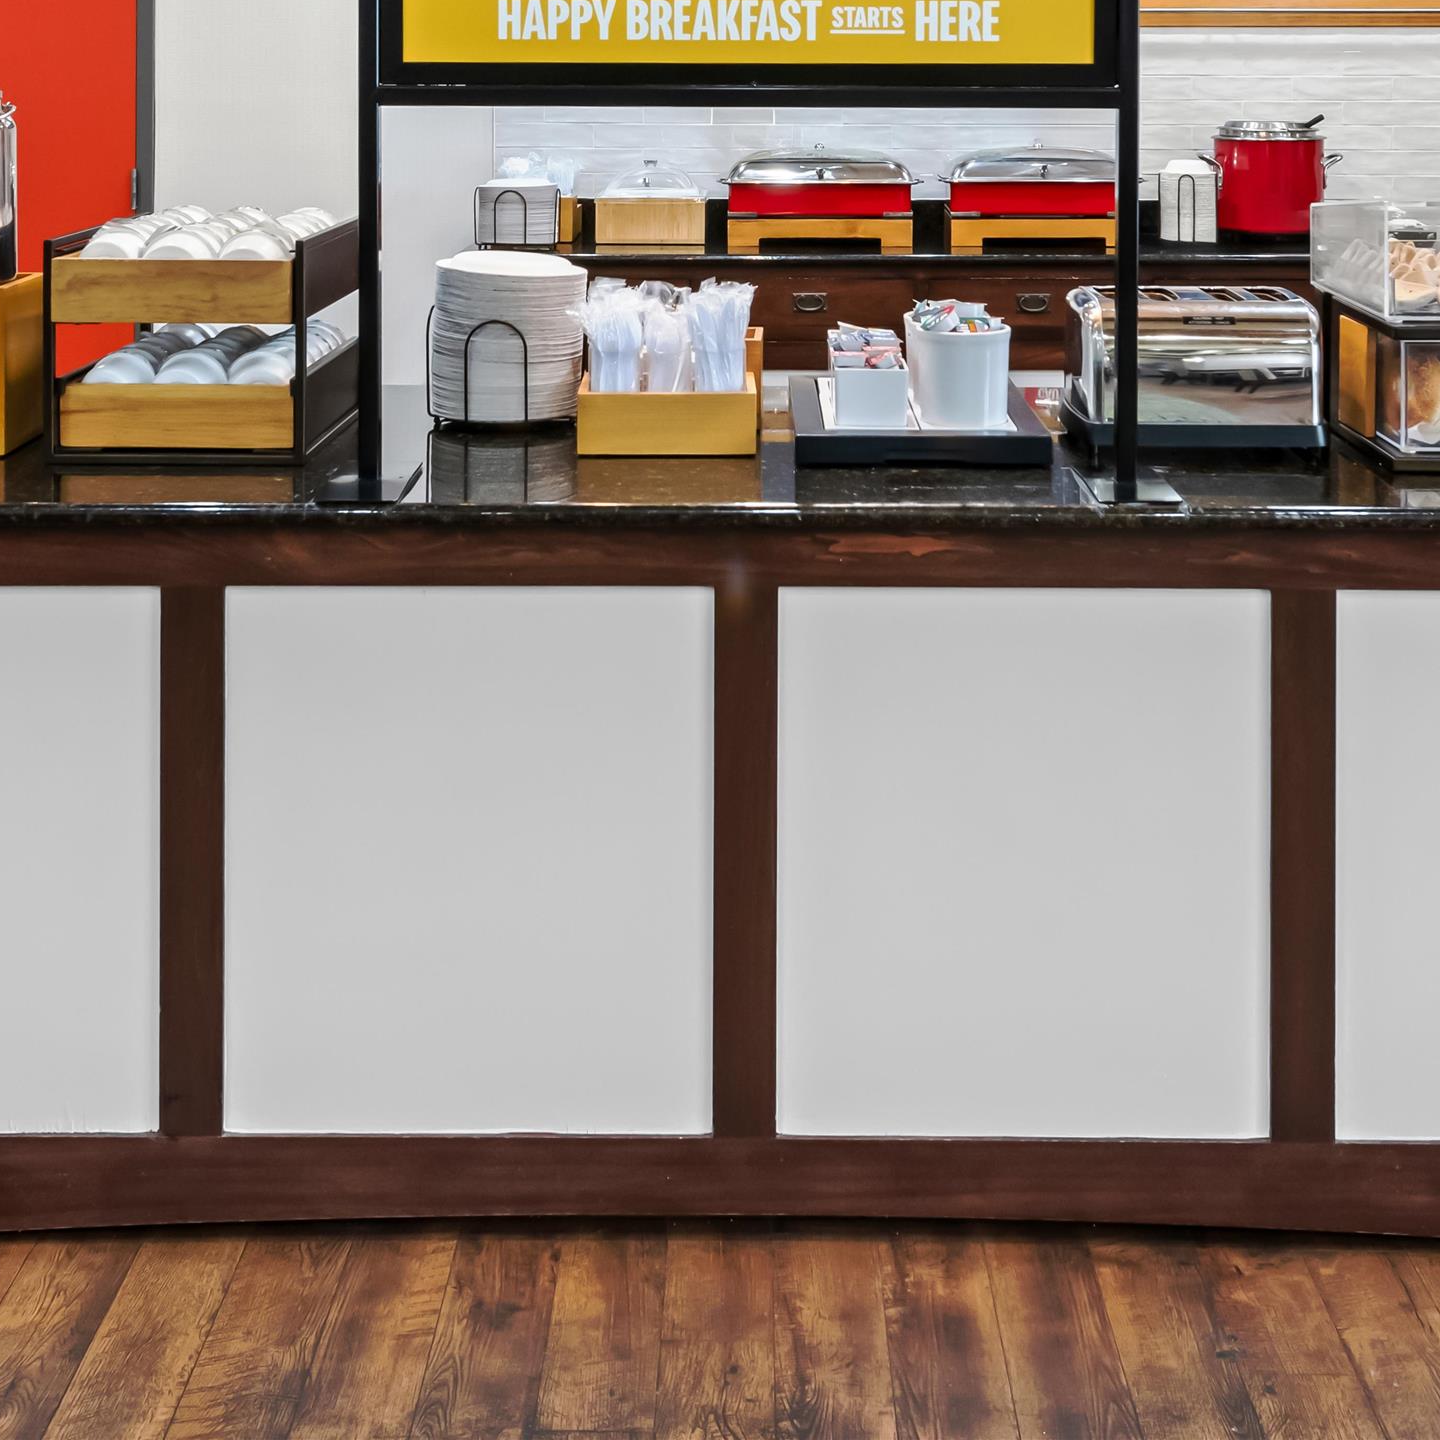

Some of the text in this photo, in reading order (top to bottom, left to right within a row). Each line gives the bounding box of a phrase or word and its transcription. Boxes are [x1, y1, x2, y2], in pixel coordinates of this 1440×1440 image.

[497, 0, 1000, 42] HAPPY BREAKFAST STARTS HERE
